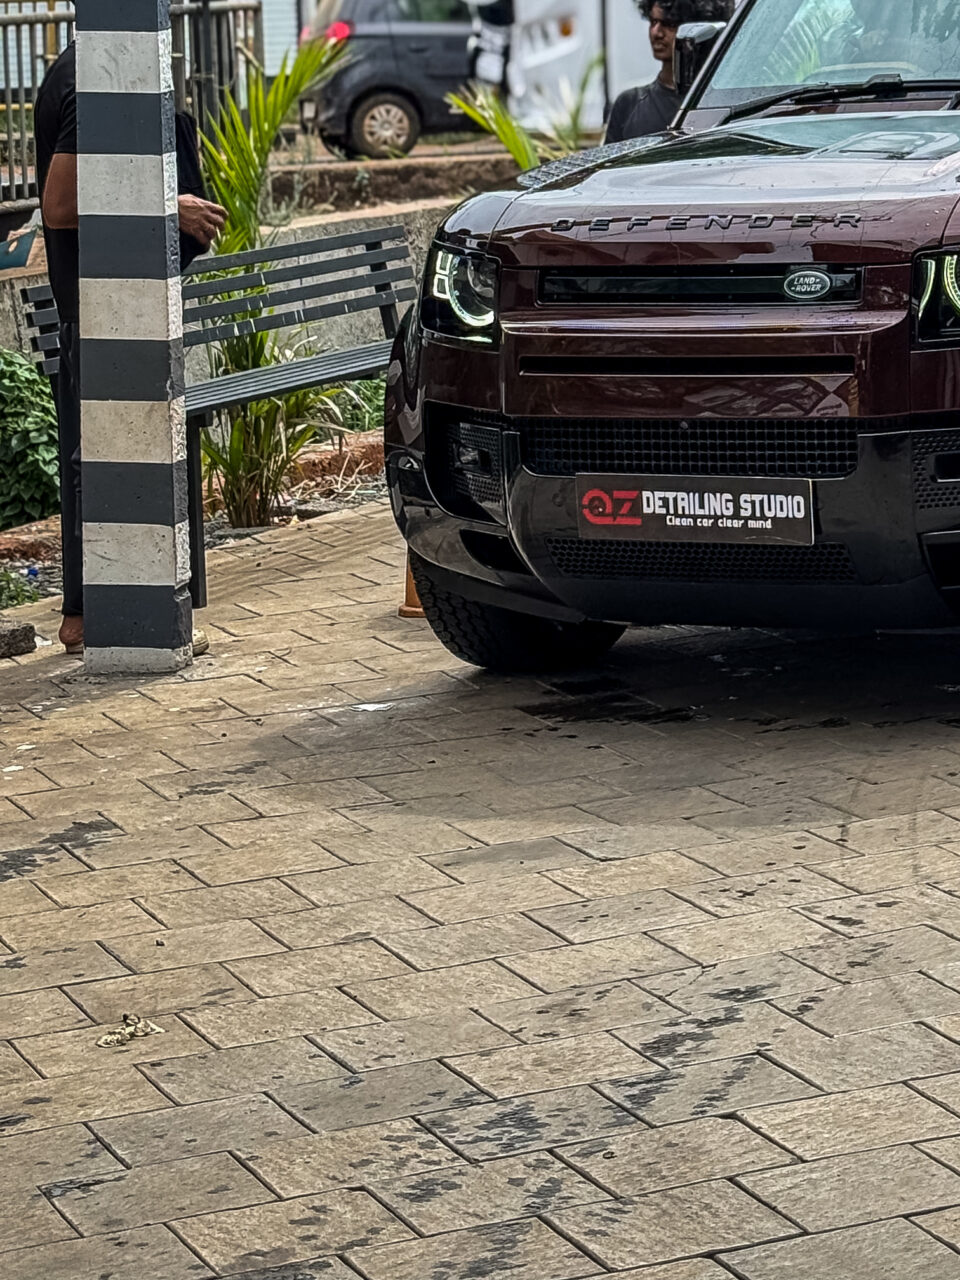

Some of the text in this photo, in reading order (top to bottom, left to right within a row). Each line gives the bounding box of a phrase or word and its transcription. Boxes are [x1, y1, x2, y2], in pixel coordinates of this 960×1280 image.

[551, 213, 862, 232] DEFENDER
[642, 490, 734, 516] DETAILING
[740, 493, 805, 519] STUDIO
[666, 515, 773, 529] Clean car clear mind
